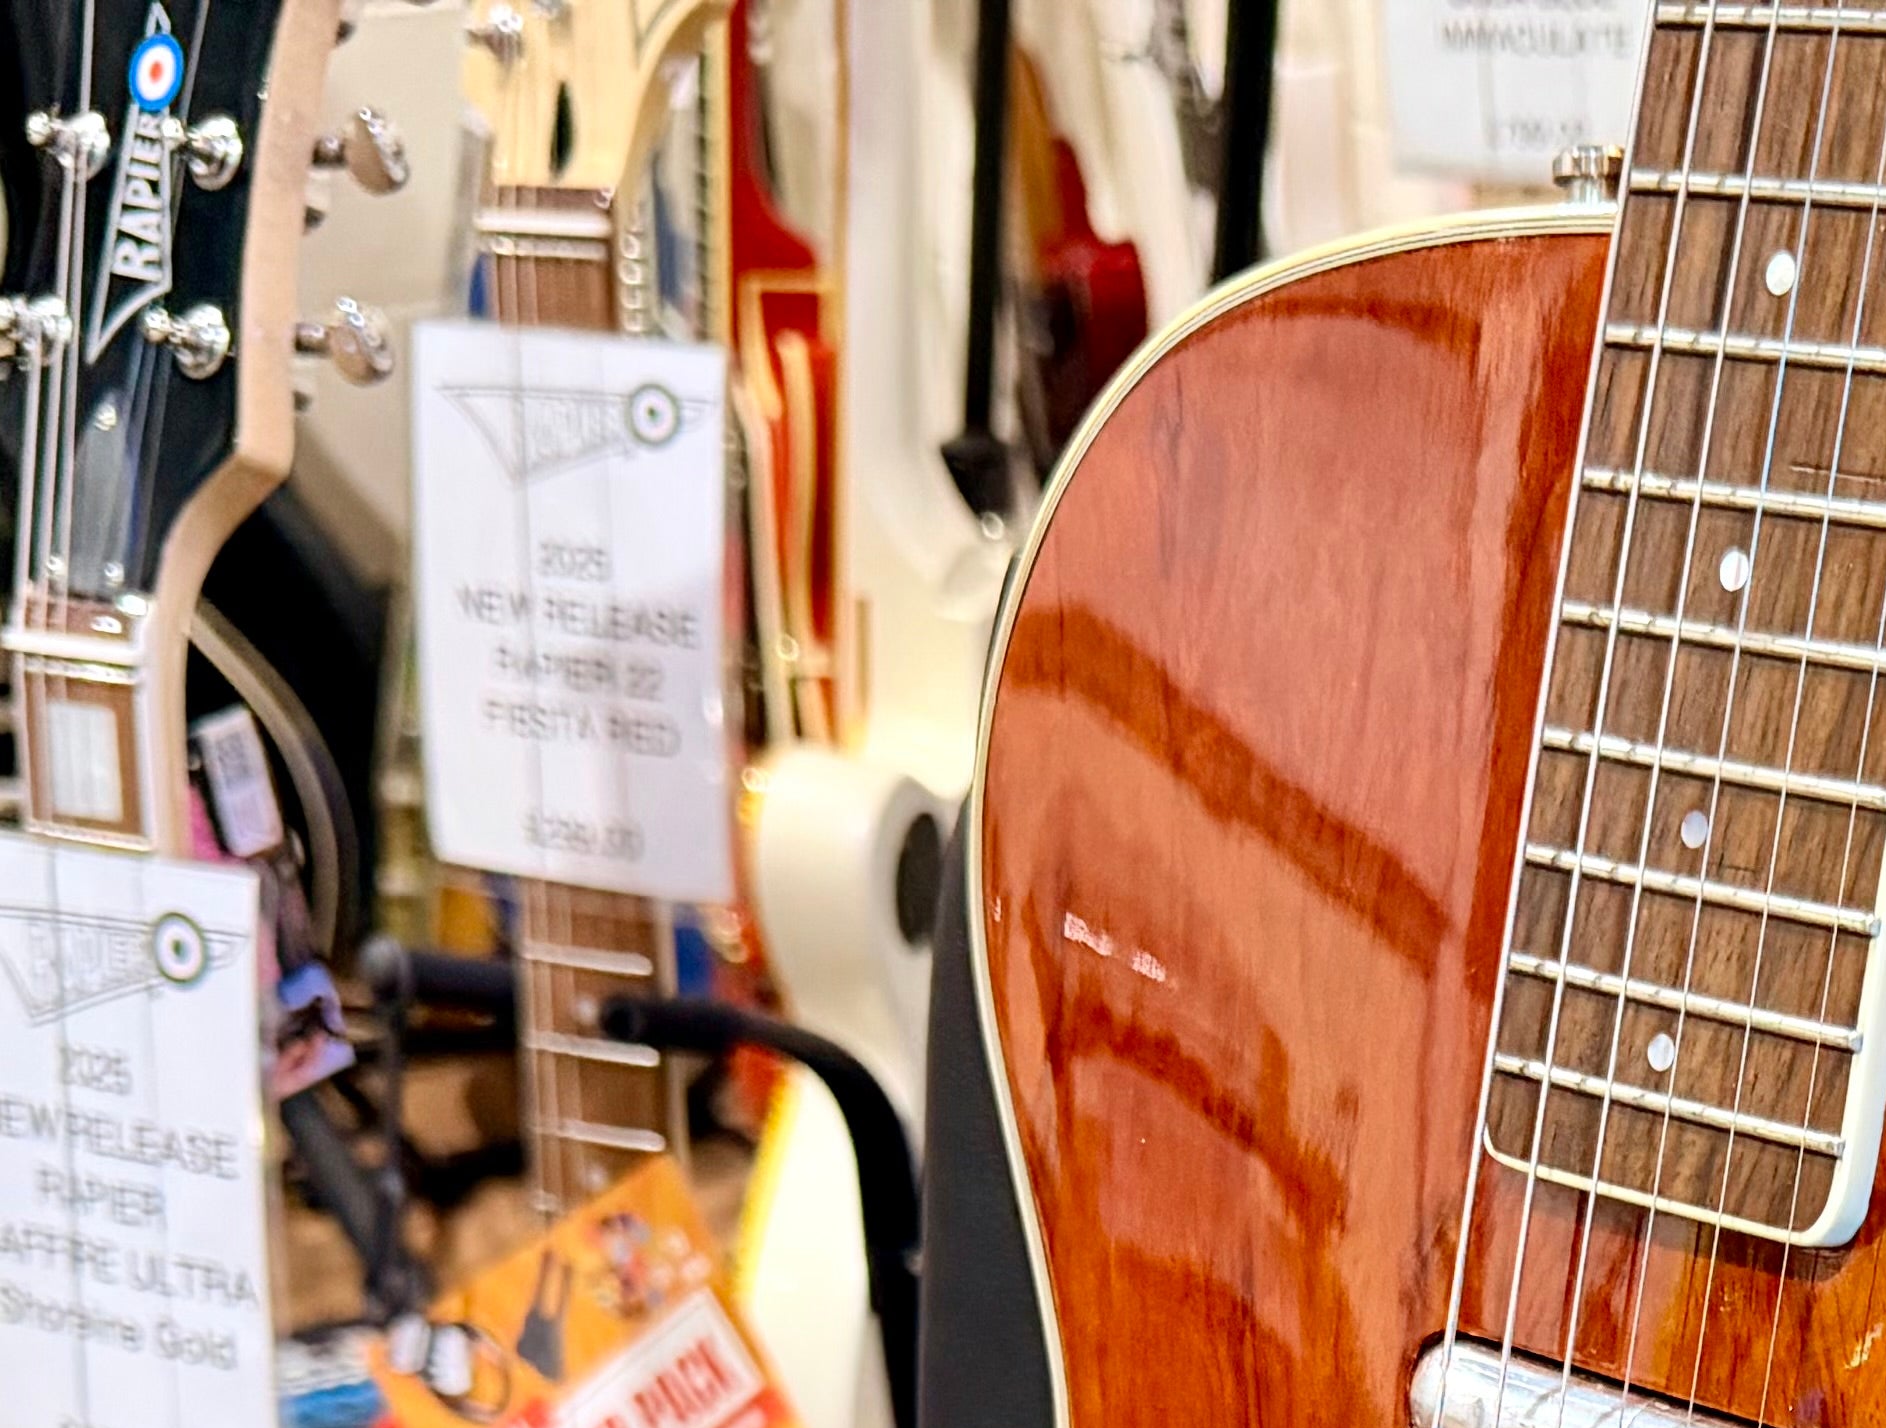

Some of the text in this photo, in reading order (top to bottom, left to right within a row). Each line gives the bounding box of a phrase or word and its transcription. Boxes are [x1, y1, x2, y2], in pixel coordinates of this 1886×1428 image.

[112, 111, 163, 283] RAPIER
[456, 584, 700, 650] NEW RELEASE
[66, 1108, 240, 1180] RELEASE
[36, 1163, 167, 1228] RAPIER
[129, 1249, 259, 1307] ULTRA
[155, 1312, 239, 1372] Gold
